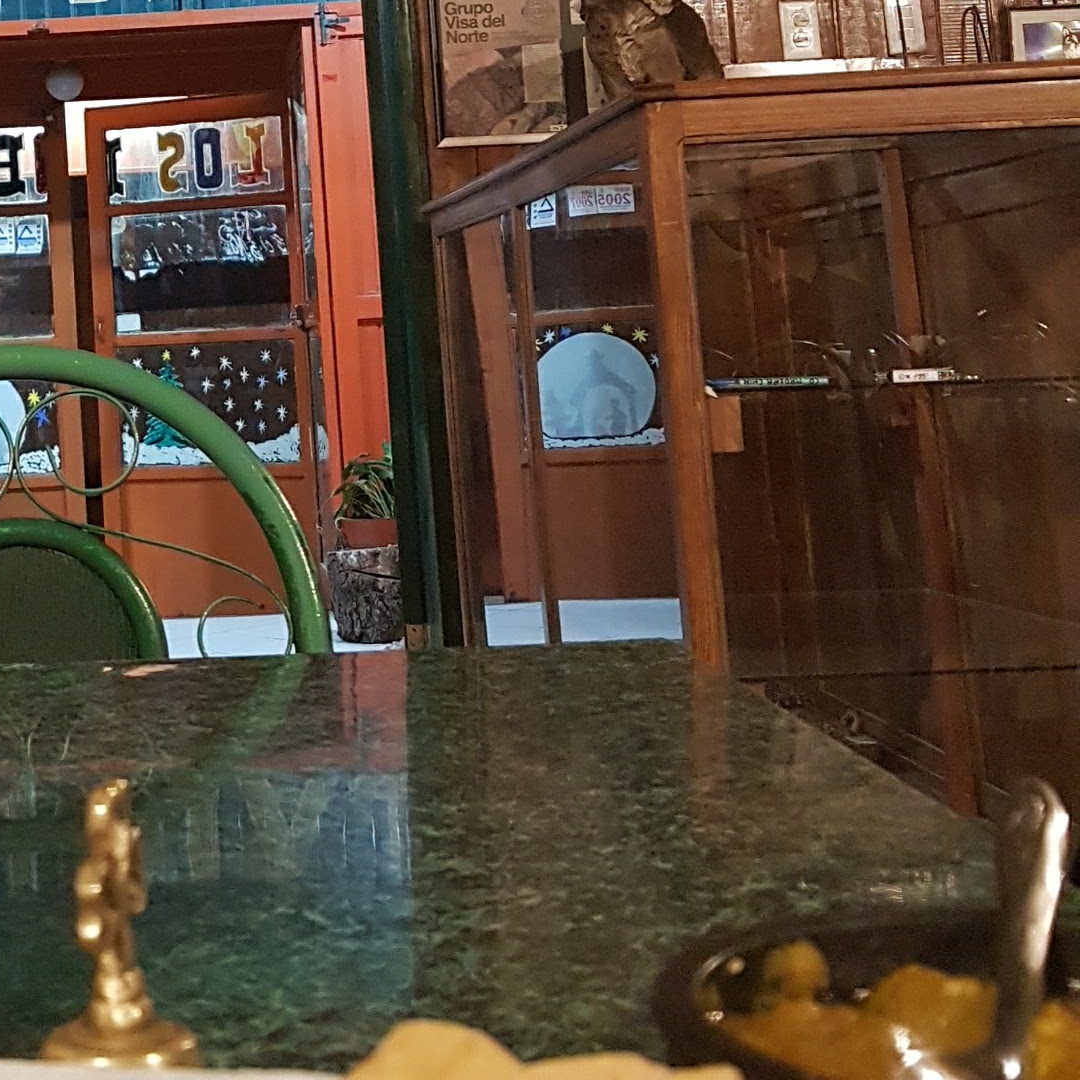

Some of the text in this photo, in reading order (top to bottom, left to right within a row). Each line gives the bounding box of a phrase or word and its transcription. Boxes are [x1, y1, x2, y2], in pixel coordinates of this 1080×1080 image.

[444, 2, 493, 17] Grupo
[444, 13, 506, 29] Visa del
[446, 30, 489, 44] Norte
